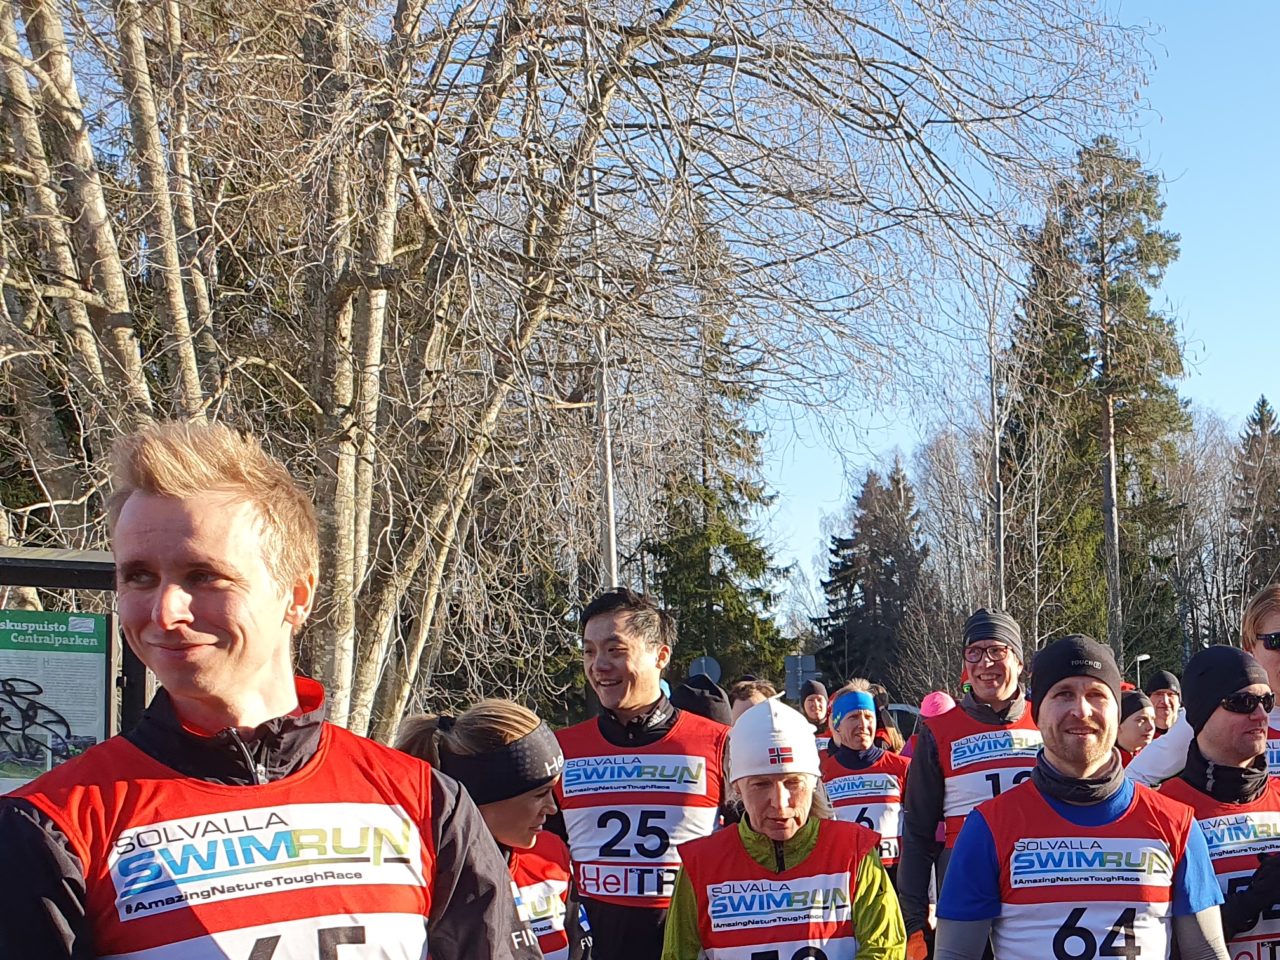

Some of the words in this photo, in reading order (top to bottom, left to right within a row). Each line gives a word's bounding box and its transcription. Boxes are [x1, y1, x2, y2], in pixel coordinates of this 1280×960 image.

[11, 633, 98, 647] Centralparken
[565, 762, 703, 785] SWIMRUN
[566, 757, 642, 769] SOLVALLA
[114, 812, 289, 855] SOLVALLA
[596, 810, 670, 859] 25
[1014, 840, 1103, 851] SOLVALLA
[118, 819, 411, 882] SWIMRUN
[1013, 850, 1171, 875] SWIMRUN
[125, 871, 363, 914] #AmazingNatureToughRace
[711, 883, 791, 898] SOLVALLA
[711, 888, 850, 915] SWIMRUN
